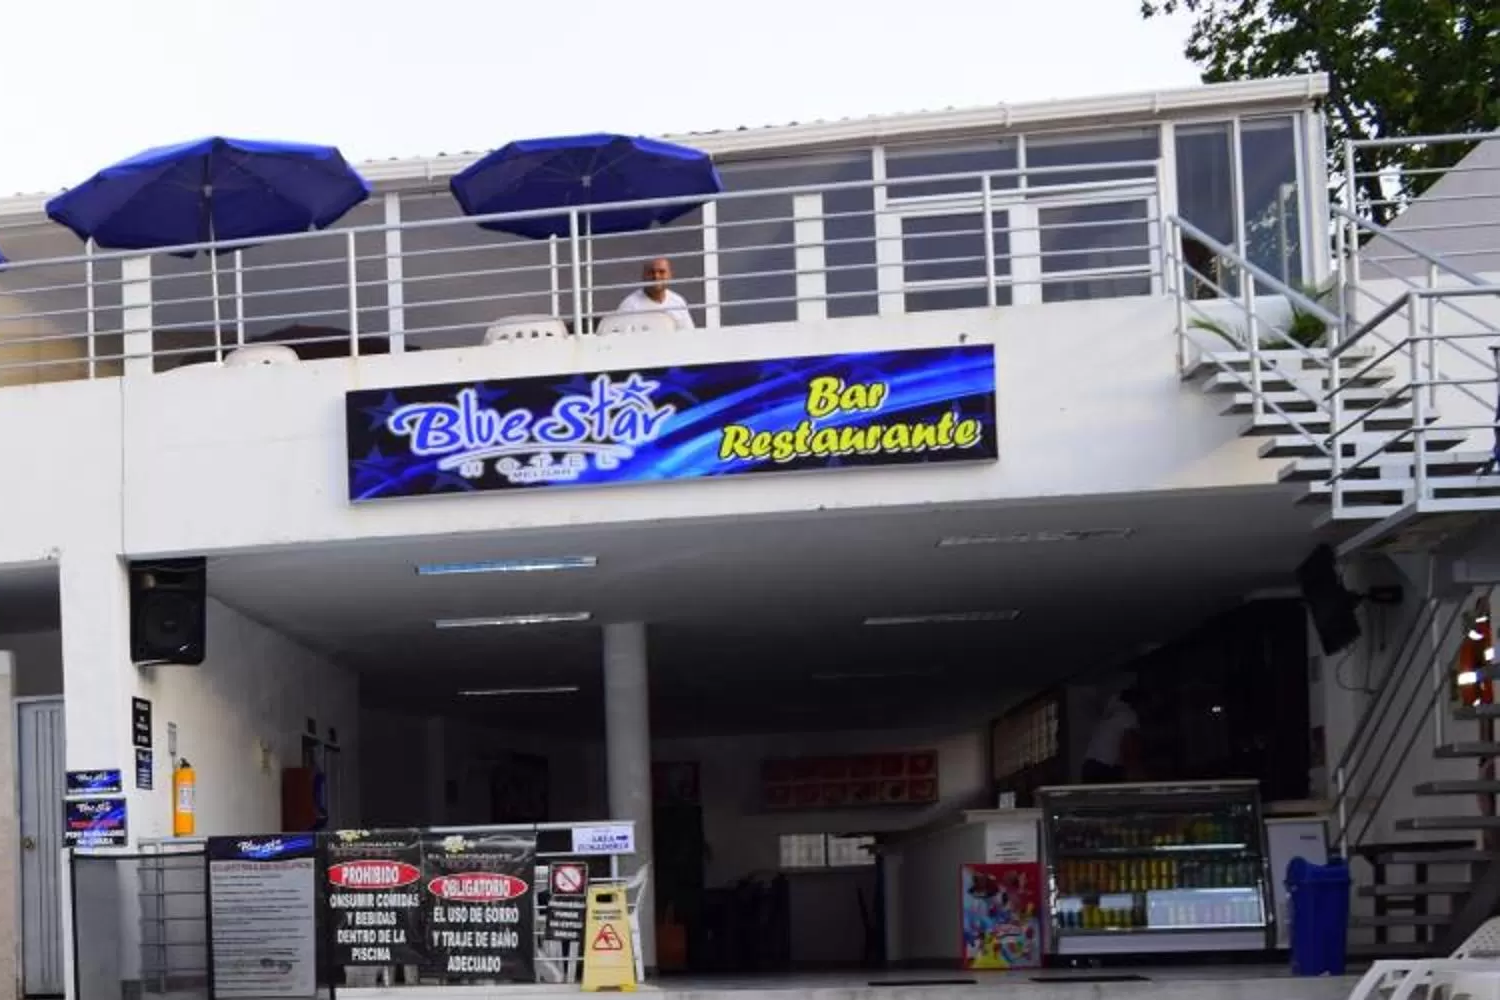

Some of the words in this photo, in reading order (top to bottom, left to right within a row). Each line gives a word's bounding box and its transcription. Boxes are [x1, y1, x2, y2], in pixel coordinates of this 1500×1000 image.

[806, 376, 887, 418] Bar
[390, 389, 532, 454] Blue
[533, 374, 676, 446] Star
[719, 411, 981, 461] Restaurante
[341, 866, 399, 885] PROHIBIDO
[442, 879, 510, 898] OBLIGATORIO
[346, 911, 354, 925] Y
[355, 911, 397, 925] BEBIDAS
[433, 906, 445, 922] EL
[447, 906, 468, 922] USO
[469, 906, 482, 922] DE
[485, 907, 519, 922] GORRO
[337, 929, 377, 943] DENTRO
[378, 929, 391, 943] DE
[393, 929, 406, 943] LA
[432, 931, 441, 947] Y
[442, 931, 472, 947] TRAJE
[475, 931, 488, 947] DE
[351, 947, 391, 961] PISCINA
[447, 956, 501, 972] ADECUADO
